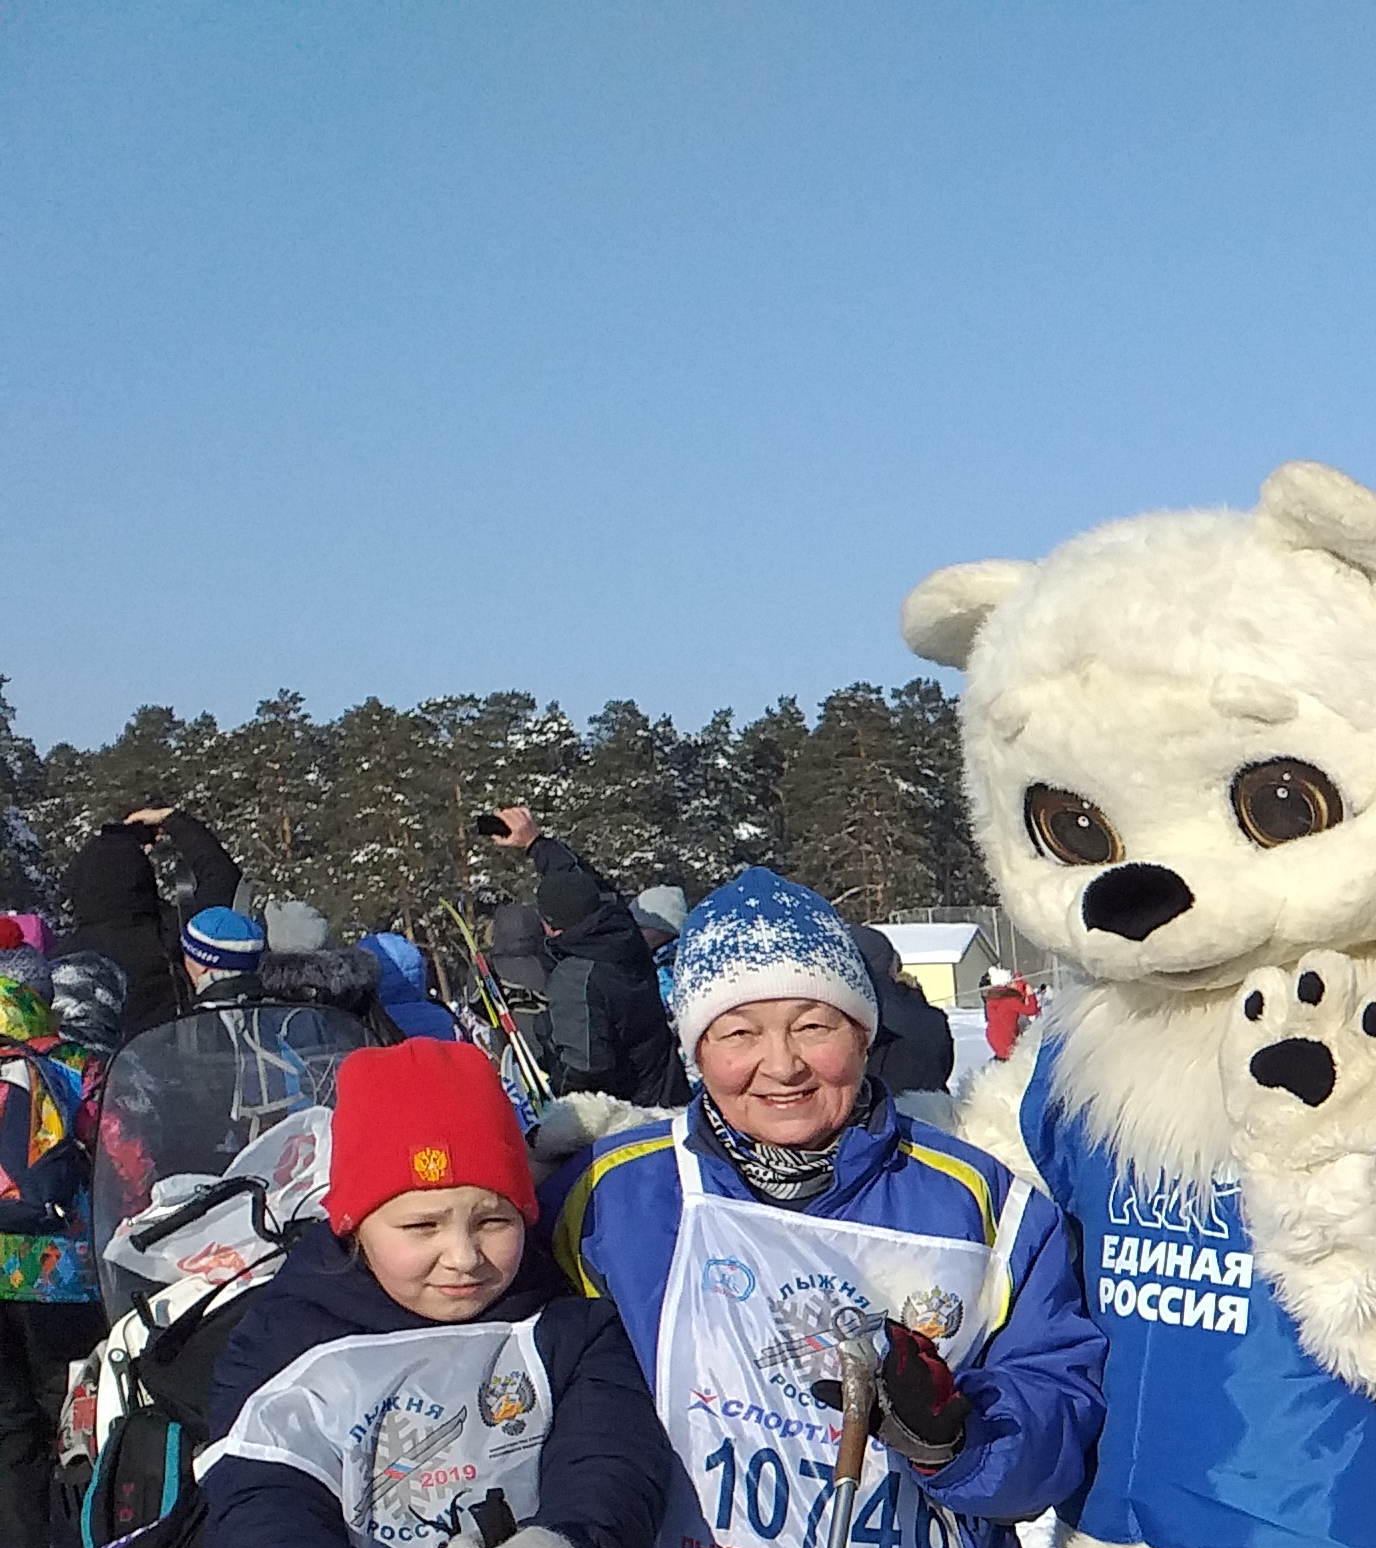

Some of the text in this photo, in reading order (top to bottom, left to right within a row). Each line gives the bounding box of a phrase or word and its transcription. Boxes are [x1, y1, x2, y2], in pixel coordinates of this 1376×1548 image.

[1101, 1234, 1255, 1290] ЕДИНАЯ
[778, 1273, 873, 1310] ЛЫЖНЯ
[1099, 1277, 1250, 1337] РОССИЯ
[419, 1464, 478, 1488] 2019
